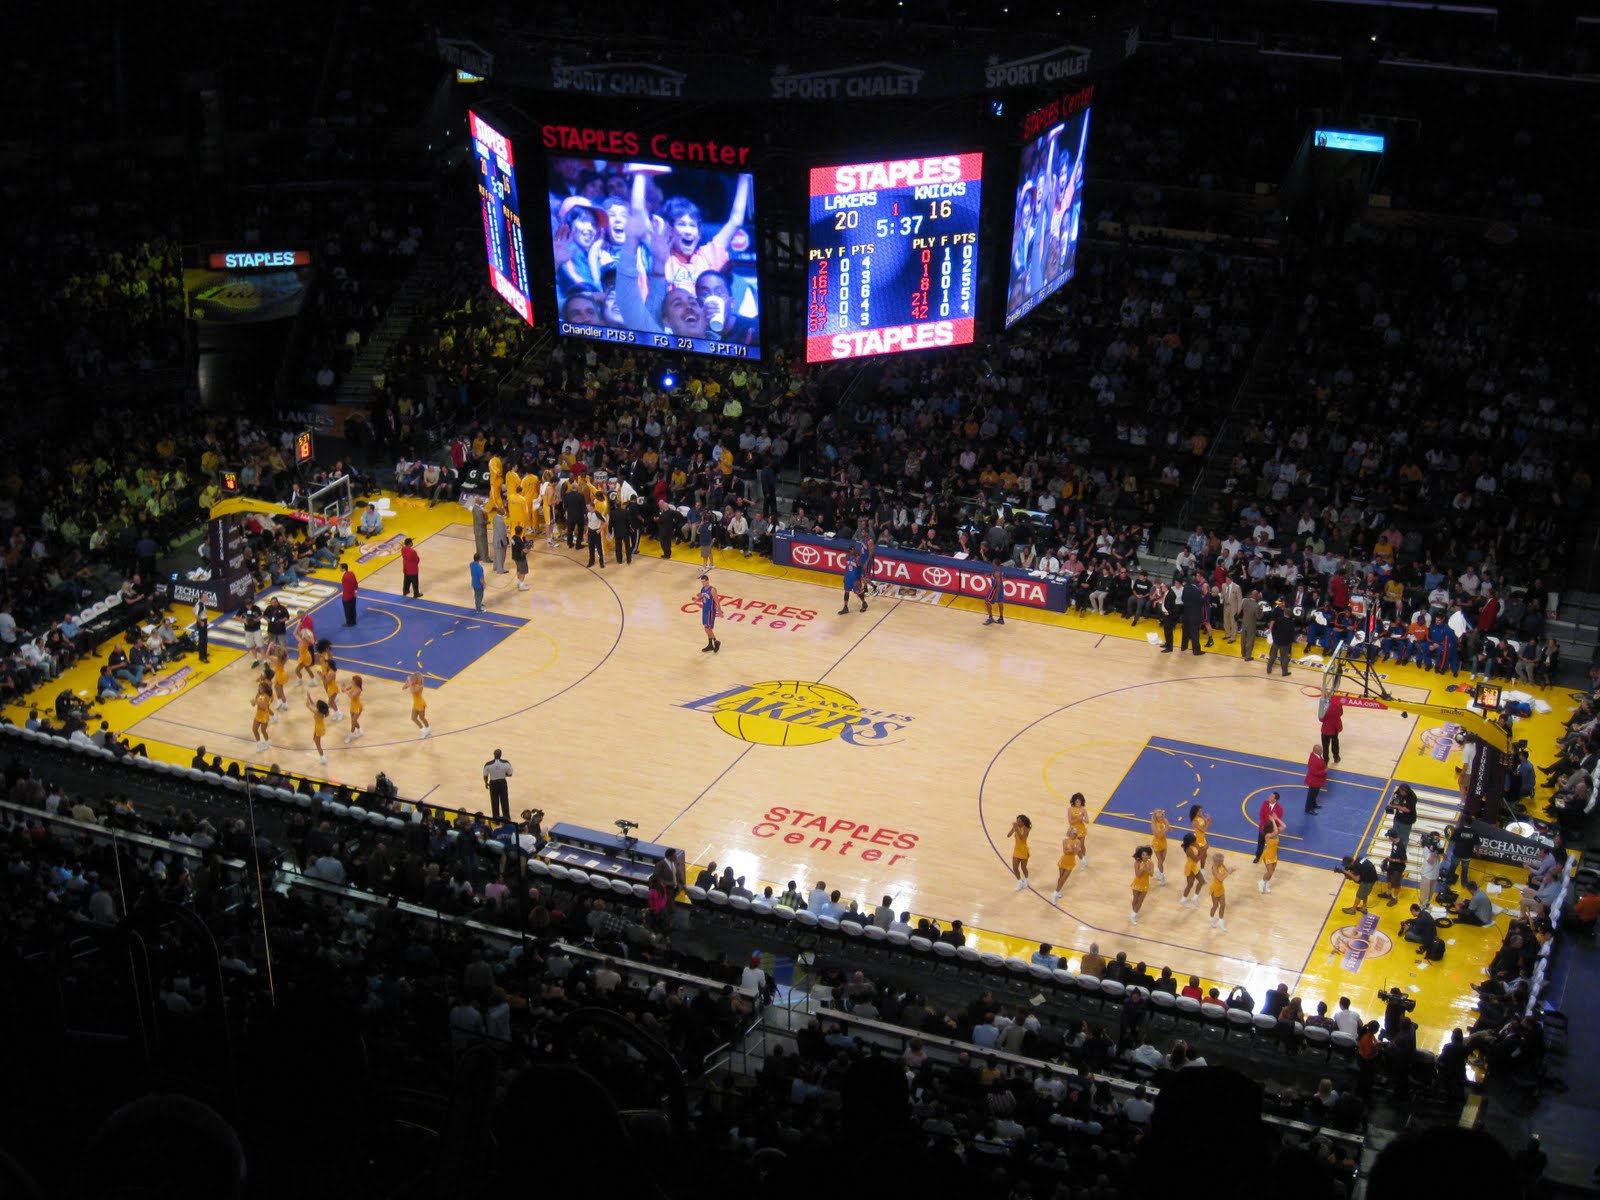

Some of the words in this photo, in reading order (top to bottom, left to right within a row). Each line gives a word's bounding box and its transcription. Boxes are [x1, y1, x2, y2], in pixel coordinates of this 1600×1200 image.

[984, 64, 1040, 88] SPORT
[1043, 54, 1091, 81] CHALET
[552, 70, 604, 92] SPORT
[609, 74, 686, 97] CHALET
[770, 77, 841, 99] SPORT
[846, 74, 924, 96] CHALET
[1024, 100, 1060, 140] STAPLES
[542, 125, 640, 155] STAPLES
[651, 134, 749, 165] Center
[835, 156, 961, 193] STAPLES
[915, 182, 966, 200] KNICKS
[825, 192, 877, 210] LAKERS
[893, 203, 899, 216] 1
[930, 200, 951, 219] 16
[835, 210, 859, 230] 20
[876, 216, 923, 237] 5:37
[913, 237, 935, 249] PLY
[941, 236, 948, 246] F
[954, 233, 976, 244] PTS
[225, 252, 295, 268] STAPLES
[810, 248, 832, 259] PLY
[839, 247, 845, 257] F
[852, 244, 874, 255] PTS
[922, 249, 931, 263] 0
[944, 247, 950, 261] 1
[963, 245, 972, 259] 0
[819, 261, 828, 274] 2
[841, 258, 849, 272] 0
[862, 256, 870, 269] 4
[923, 264, 929, 277] 1
[942, 261, 951, 275] 0
[962, 259, 971, 273] 2
[812, 276, 828, 290] 16
[840, 273, 849, 286] 0
[861, 271, 870, 283] 3
[921, 278, 929, 291] 8
[941, 275, 950, 289] 0
[962, 273, 971, 287] 5
[812, 290, 827, 304] 17
[840, 287, 849, 300] 0
[861, 285, 870, 298] 6
[912, 293, 928, 306] 21
[943, 289, 948, 303] 1
[961, 287, 970, 301] 5
[810, 304, 827, 318] 24
[839, 301, 848, 314] 0
[861, 299, 869, 312] 4
[912, 307, 928, 320] 42
[940, 303, 949, 317] 0
[961, 301, 969, 314] 4
[809, 318, 827, 332] 37
[839, 315, 848, 328] 0
[860, 313, 869, 326] 3
[562, 323, 602, 337] Chandler
[607, 330, 626, 341] PTS
[628, 332, 635, 341] 5
[654, 335, 669, 346] FG
[678, 338, 693, 349] 2/3
[710, 342, 716, 352] 3
[717, 343, 731, 354] PT
[733, 345, 748, 356] 1/1
[831, 321, 953, 358] STAPLES
[470, 470, 477, 478] G
[482, 472, 490, 480] G
[637, 496, 644, 505] G
[823, 551, 910, 579] TOOTA
[174, 585, 217, 601] PECHAGA
[767, 691, 806, 702] LOS
[813, 699, 916, 722] ANGELES
[1348, 698, 1380, 708] AAA.com
[681, 684, 907, 747] LAKERS
[764, 806, 919, 850] STAPLES
[752, 822, 905, 866] Center
